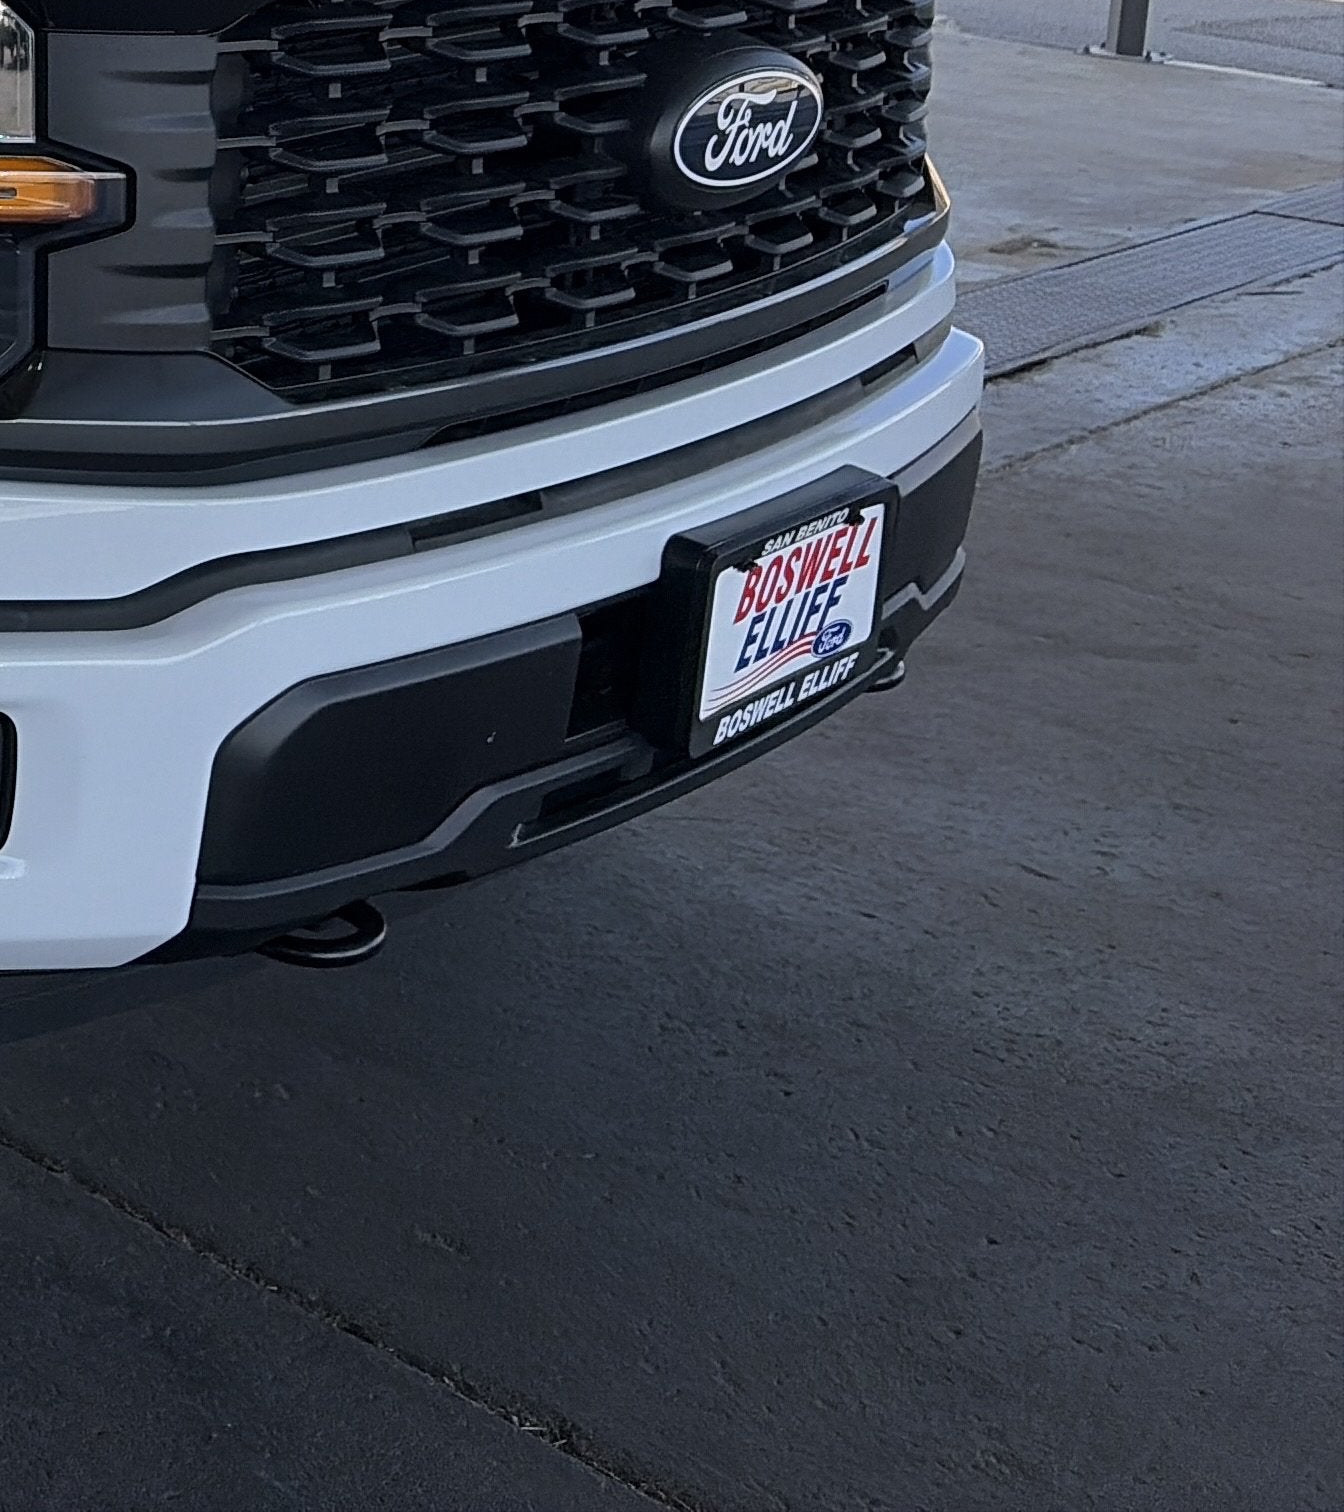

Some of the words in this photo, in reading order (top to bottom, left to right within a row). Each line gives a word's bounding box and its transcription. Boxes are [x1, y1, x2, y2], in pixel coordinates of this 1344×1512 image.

[704, 88, 799, 172] Ford
[733, 516, 878, 625] BOSWELL
[762, 529, 794, 555] SAN
[795, 507, 850, 541] BENITO
[734, 575, 849, 673] ELLIFF
[817, 629, 848, 652] Ford
[713, 687, 794, 746] BOSWELL
[797, 652, 860, 698] ELLIFF
